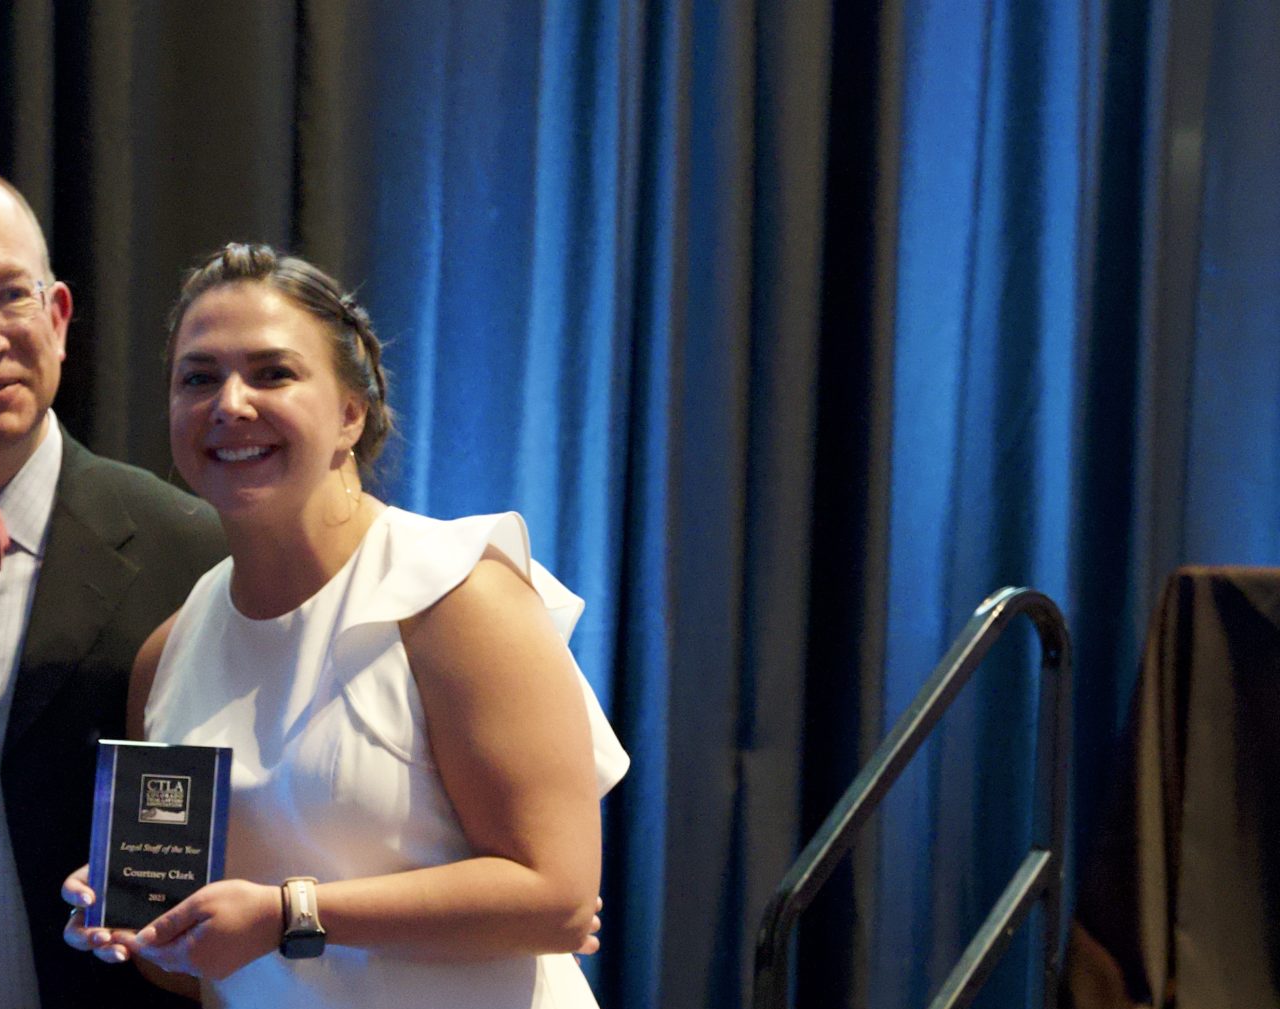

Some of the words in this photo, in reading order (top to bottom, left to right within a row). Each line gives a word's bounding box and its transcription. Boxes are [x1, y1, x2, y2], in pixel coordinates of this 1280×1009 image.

[147, 779, 184, 792] CTLA
[120, 841, 143, 853] Legal
[143, 843, 163, 854] Staff
[161, 844, 171, 855] of
[171, 845, 183, 854] the
[185, 845, 201, 854] Year
[123, 867, 167, 881] Courtney
[168, 869, 195, 881] Clark
